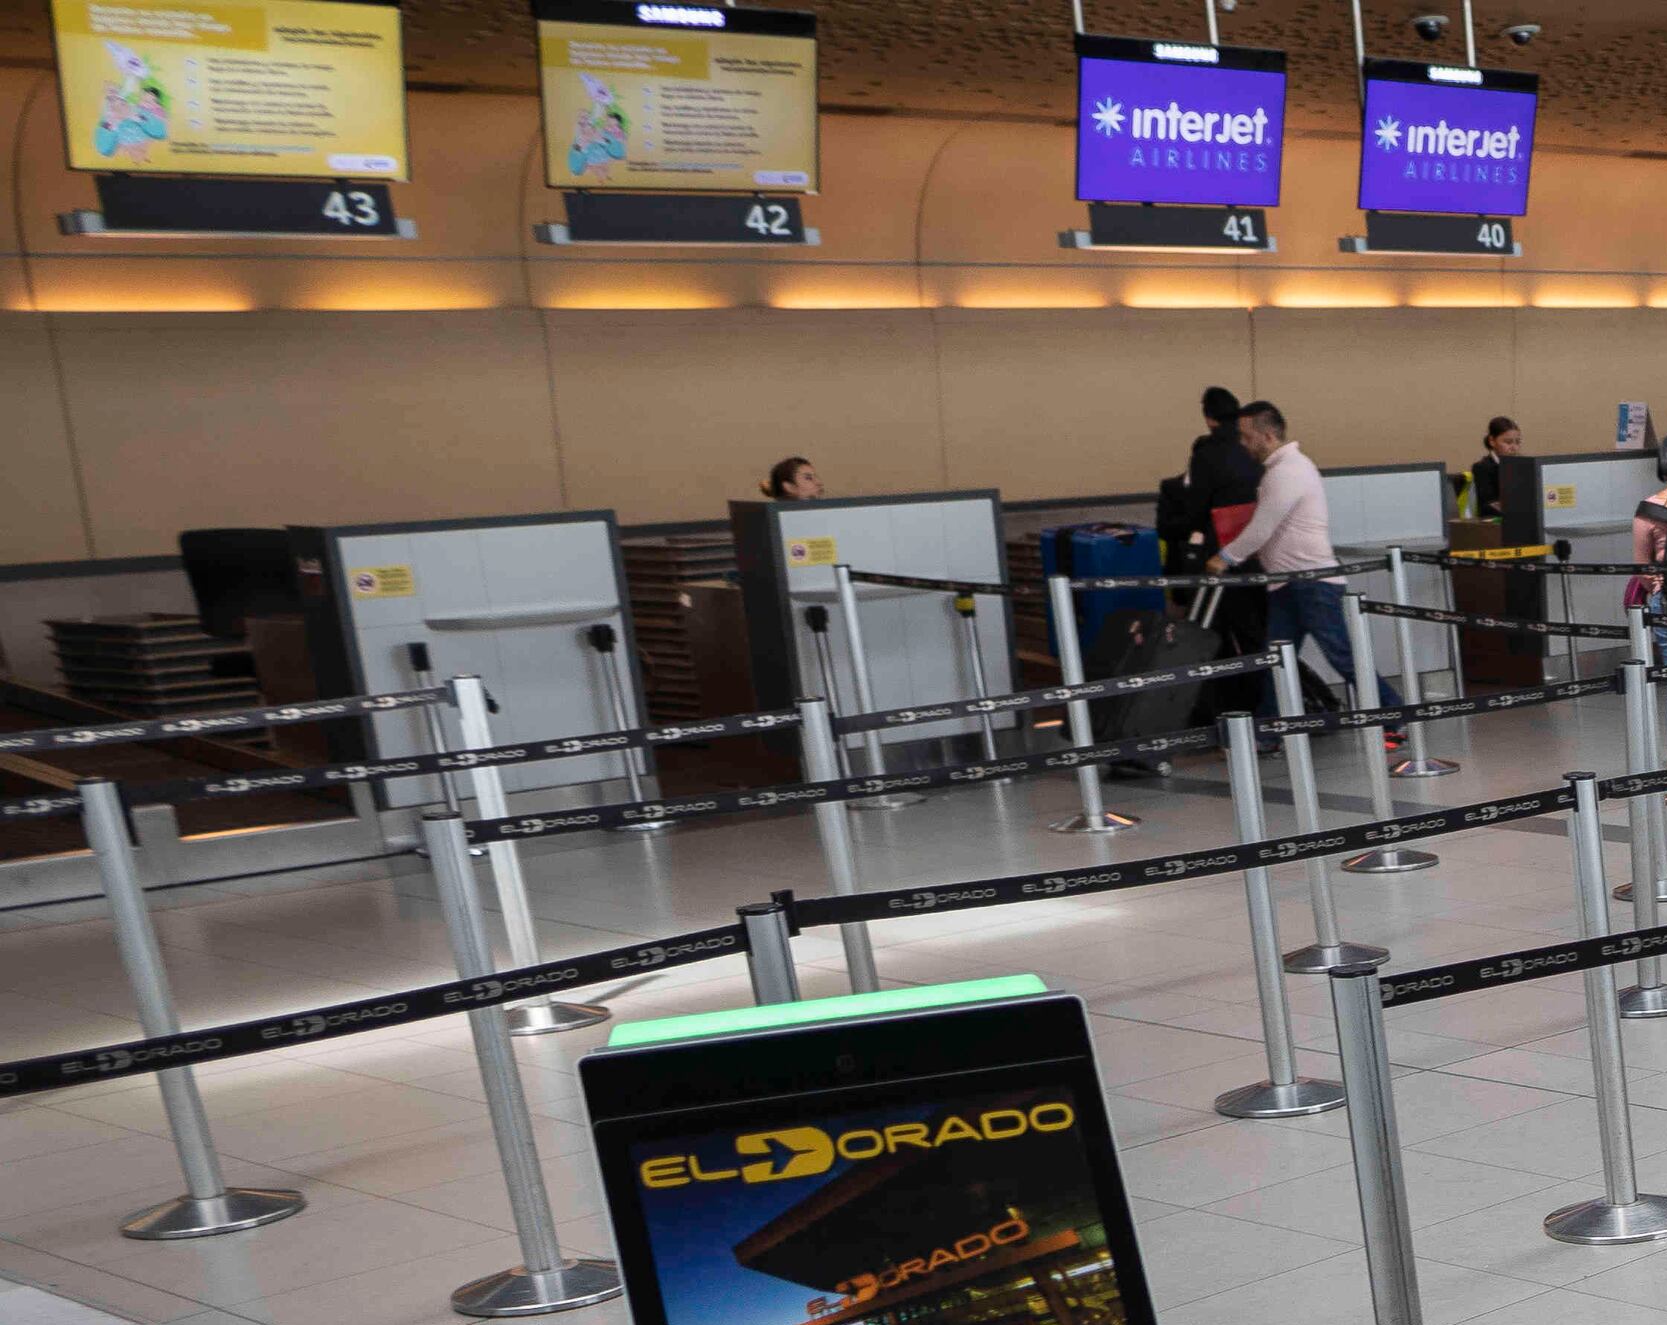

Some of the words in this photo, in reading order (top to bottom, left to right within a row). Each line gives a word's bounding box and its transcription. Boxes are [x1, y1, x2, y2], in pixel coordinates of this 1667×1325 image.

[1131, 101, 1268, 146] interjet
[1407, 120, 1519, 160] interjet
[1129, 148, 1268, 173] AIRLINES
[1403, 162, 1518, 184] AIRLINES
[323, 191, 381, 227] 43
[745, 205, 791, 237] 42
[1223, 215, 1258, 243] 41
[1476, 223, 1505, 249] 40
